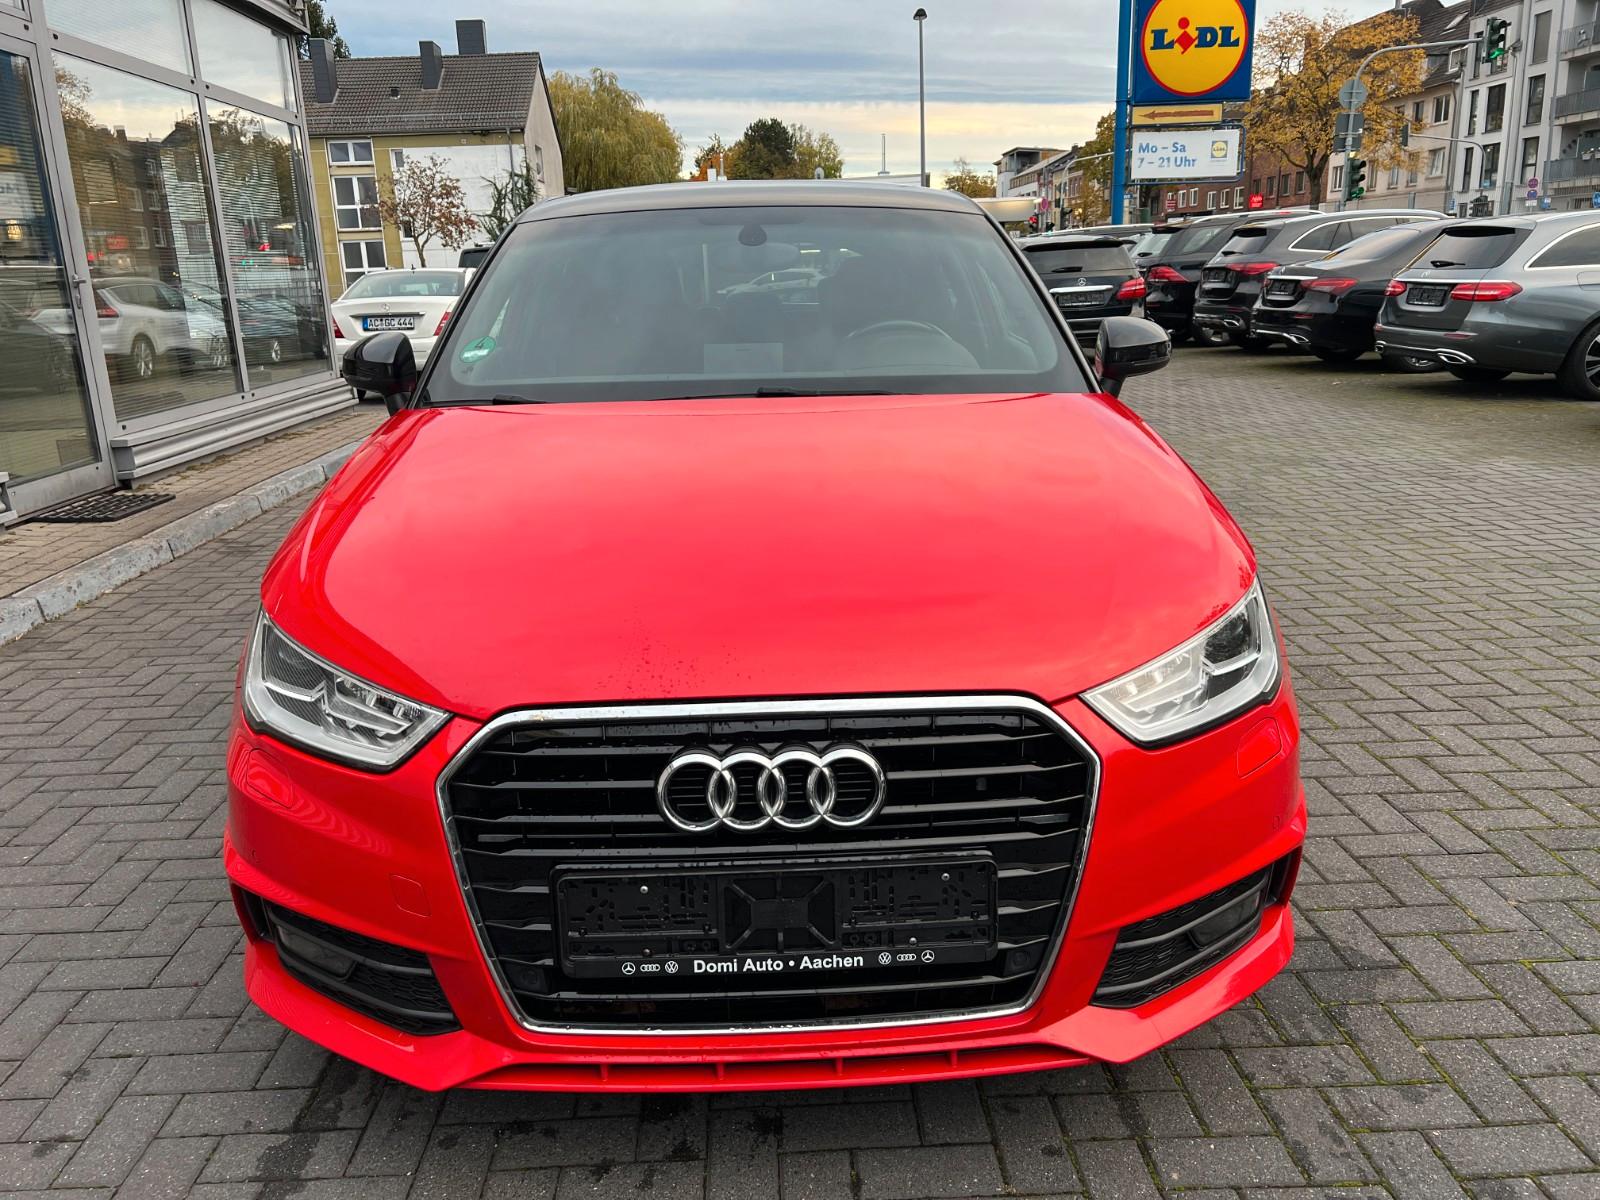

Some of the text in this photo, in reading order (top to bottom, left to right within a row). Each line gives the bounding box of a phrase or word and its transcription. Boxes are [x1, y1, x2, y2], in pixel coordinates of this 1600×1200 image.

[1138, 143, 1158, 154] Mo
[1172, 142, 1187, 153] Sa
[1137, 157, 1145, 168] 7
[1158, 156, 1171, 168] 21
[1174, 155, 1198, 168] Uhr
[369, 318, 380, 328] AC
[397, 317, 413, 327] 444
[693, 955, 864, 973] Domi Auto Aachen
